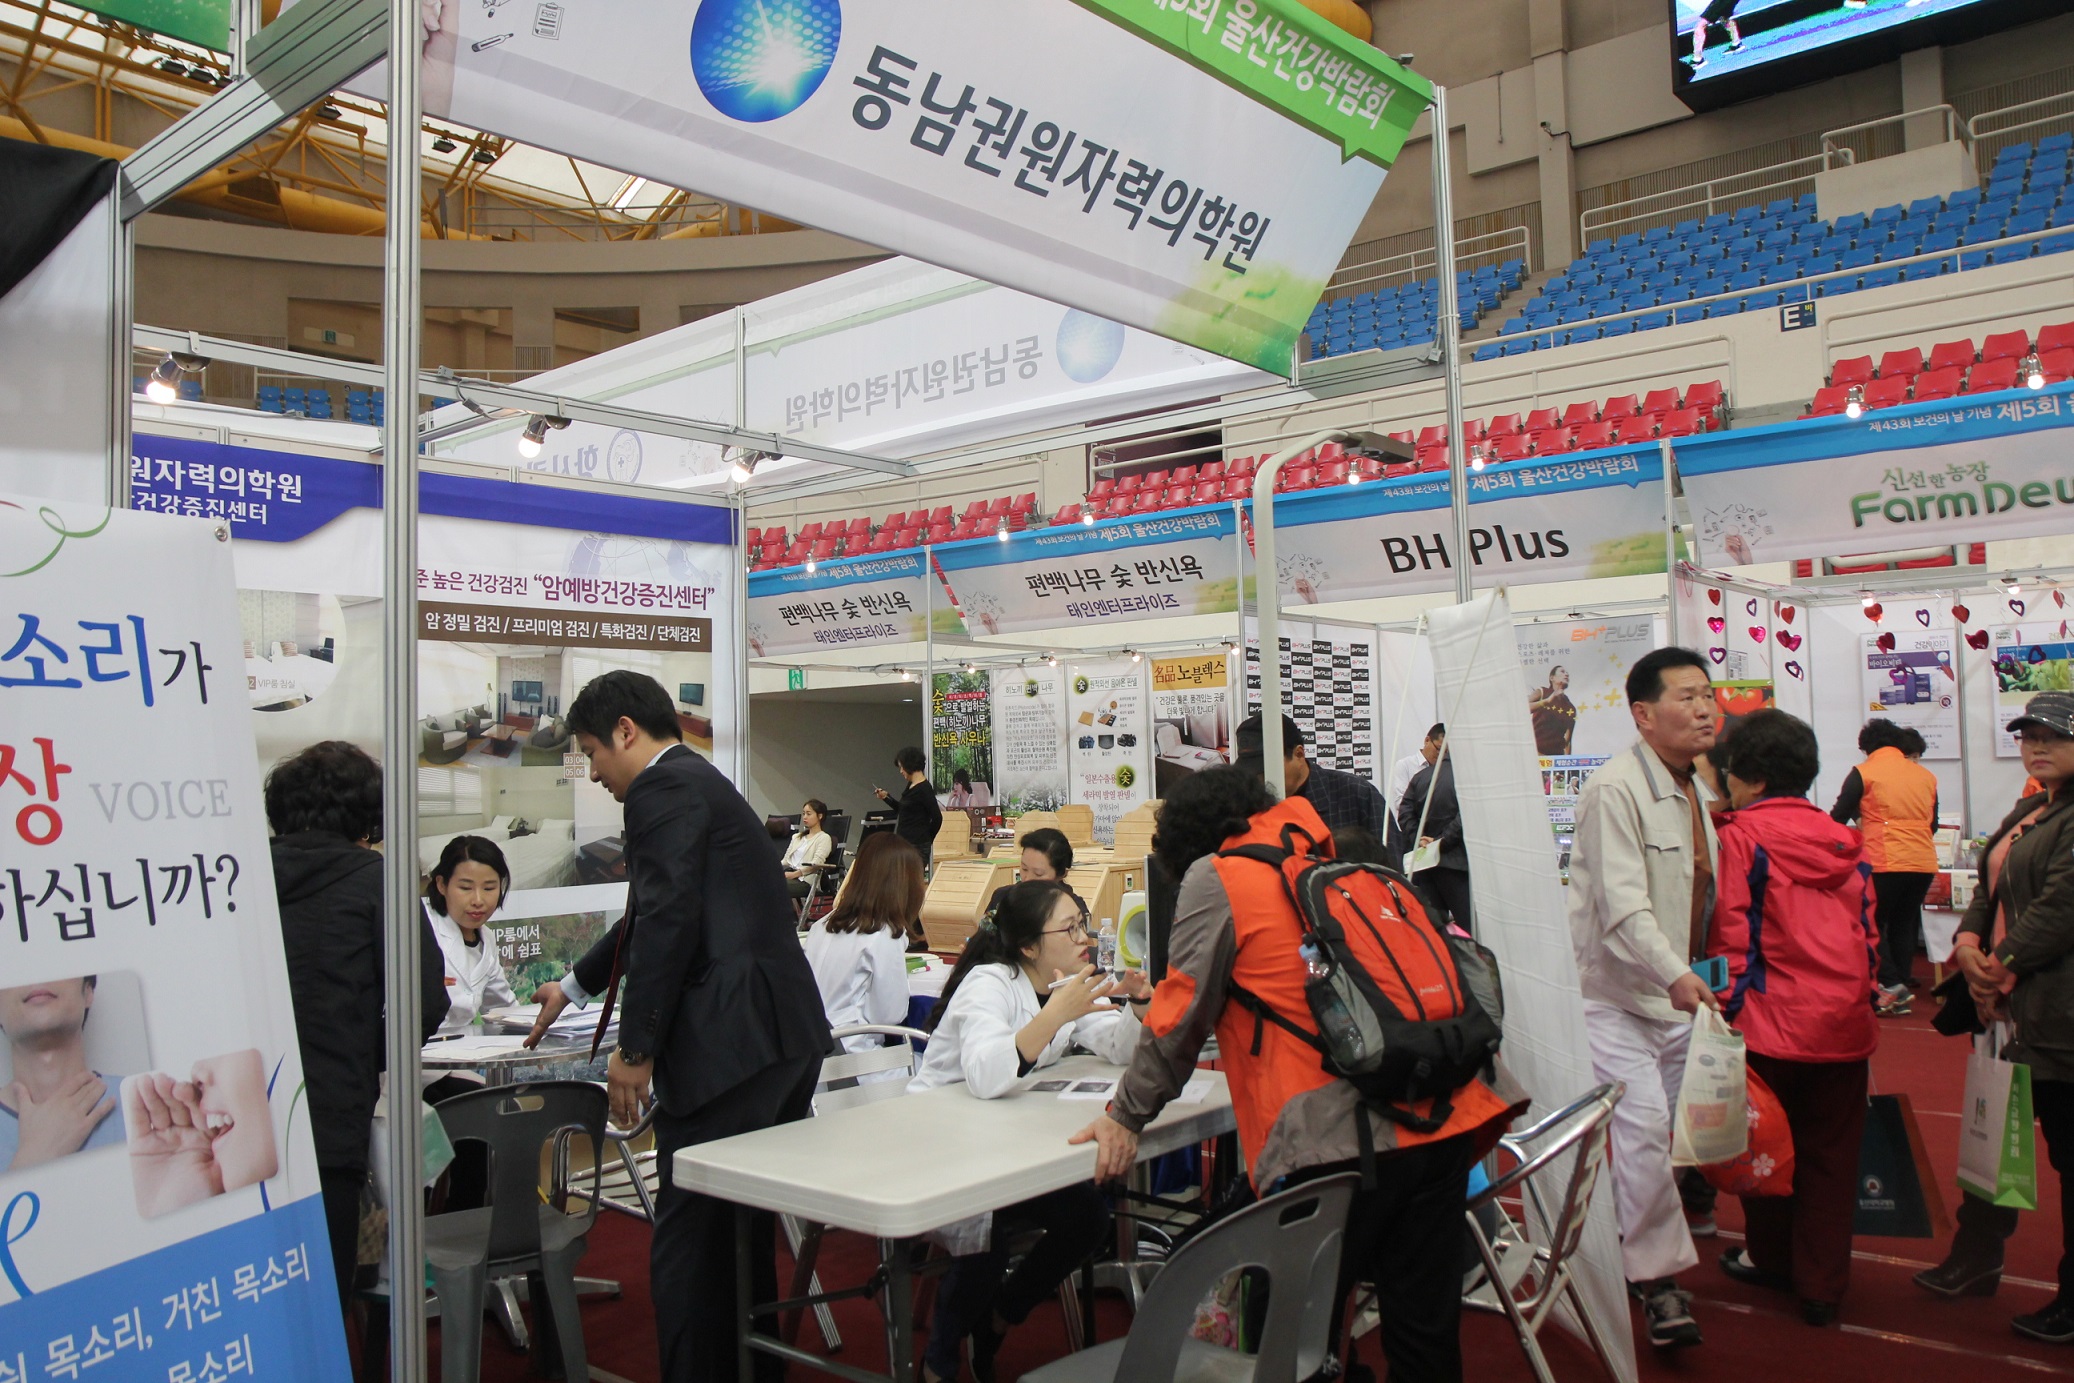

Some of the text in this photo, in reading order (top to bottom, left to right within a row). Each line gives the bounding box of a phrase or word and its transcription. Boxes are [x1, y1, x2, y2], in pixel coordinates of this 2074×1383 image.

[1220, 0, 1396, 130] 울산건강박람회
[851, 44, 1271, 275] 동남권원자력의학원
[1783, 305, 1801, 329] E
[1913, 411, 1950, 427] 보건의
[1952, 411, 1965, 423] 날
[1967, 406, 1992, 420] 기념
[1997, 394, 2060, 423] 제5회
[1383, 485, 1414, 498] 제43회
[1414, 484, 1440, 495] 보건의
[1472, 471, 1516, 493] 제5회
[1518, 455, 1639, 487] 울산건강박람회
[1881, 460, 1991, 492] 신선한 농장
[132, 490, 267, 525] 건강증진센터
[1100, 525, 1133, 542] 제5회
[1133, 512, 1222, 538] 울산건강박람회
[1380, 524, 1570, 574] BH Plus
[829, 564, 854, 580] 제5회
[853, 555, 919, 577] 울산건강박람회
[1025, 554, 1203, 598] 편백나무 숯 반신욕
[432, 570, 465, 591] 높은
[467, 573, 528, 597] 건강검진
[778, 591, 913, 627] 편백나무 숯 반신욕
[1066, 592, 1181, 619] 태인엔터프라이즈
[425, 612, 441, 631] 암
[443, 612, 471, 633] 정밀
[474, 614, 501, 634] 검진
[511, 618, 563, 637] 프리미엄
[565, 620, 591, 639] 검진
[599, 622, 648, 642] 특화검진
[657, 625, 702, 644] 단체검진
[813, 623, 899, 645] 태인엔터프라이즈
[257, 679, 279, 689] VIP룸
[1154, 660, 1226, 684] 名品 노블렉스
[932, 688, 945, 715] 숯
[933, 730, 986, 748] 반신욕 사우나
[565, 755, 585, 765] 03 04
[565, 767, 574, 777] 05
[1120, 768, 1132, 785] 숯
[89, 779, 232, 824] VOICE
[492, 924, 540, 943] IP룸에서
[497, 942, 542, 960] 에 쉼표
[45, 1306, 154, 1381] 목소리,
[162, 1276, 223, 1331] 거친
[232, 1242, 311, 1304] 목소리
[167, 1333, 254, 1383] 목소리
